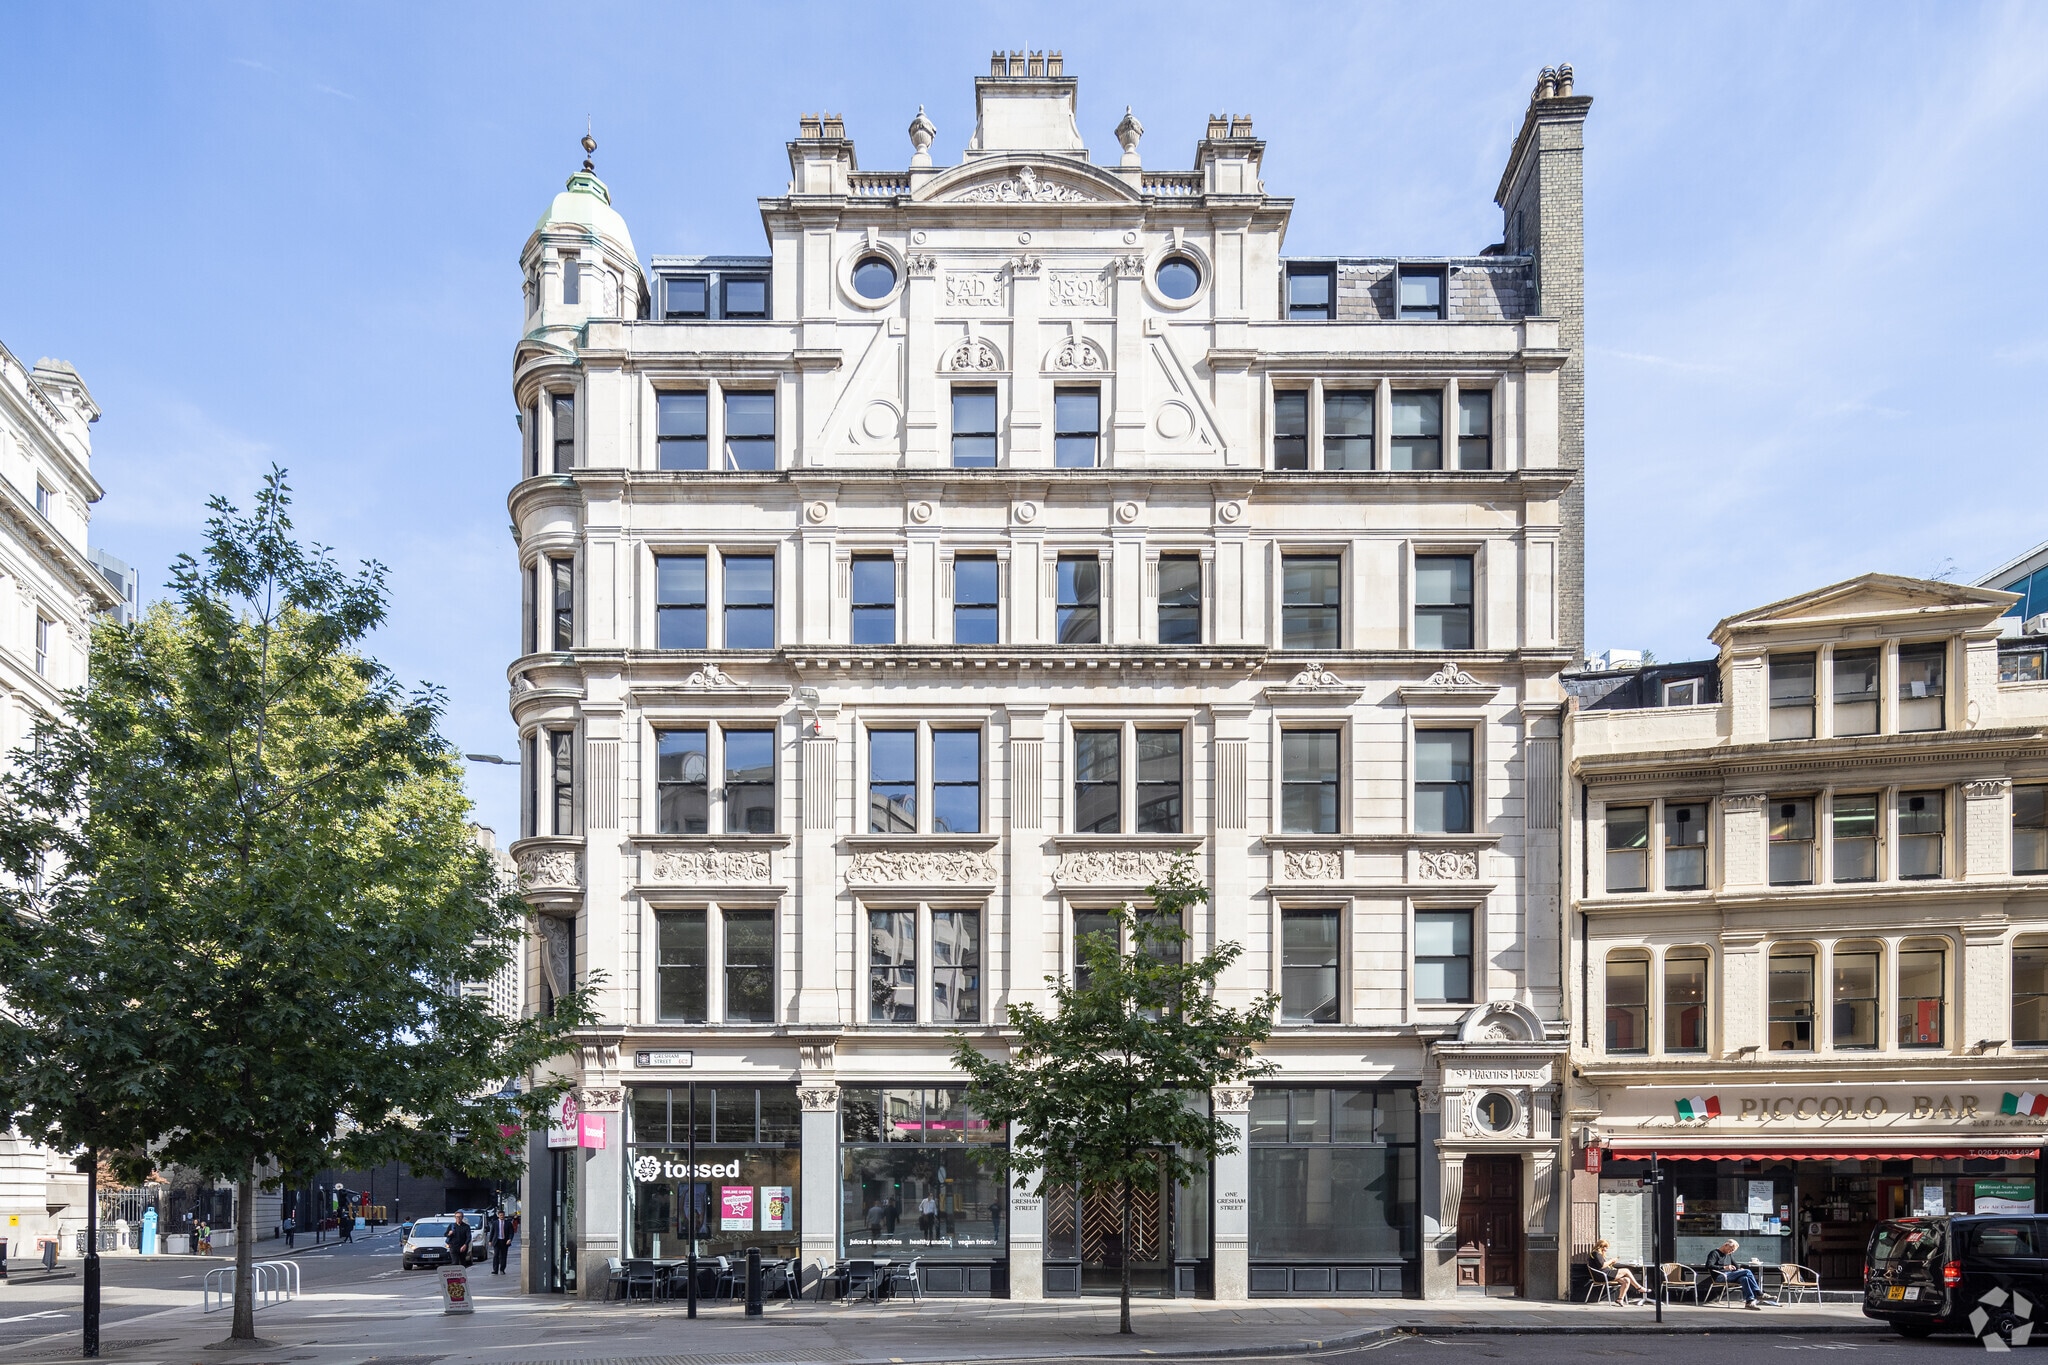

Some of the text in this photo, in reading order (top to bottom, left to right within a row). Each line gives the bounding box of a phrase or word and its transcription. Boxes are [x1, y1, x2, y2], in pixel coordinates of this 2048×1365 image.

[1511, 1068, 1540, 1080] HOUSE
[1488, 1102, 1496, 1125] 1
[1740, 1094, 1982, 1120] PICCOLO BAR
[663, 1159, 740, 1179] tossed
[724, 1195, 750, 1204] welcome
[909, 1238, 931, 1246] healthy
